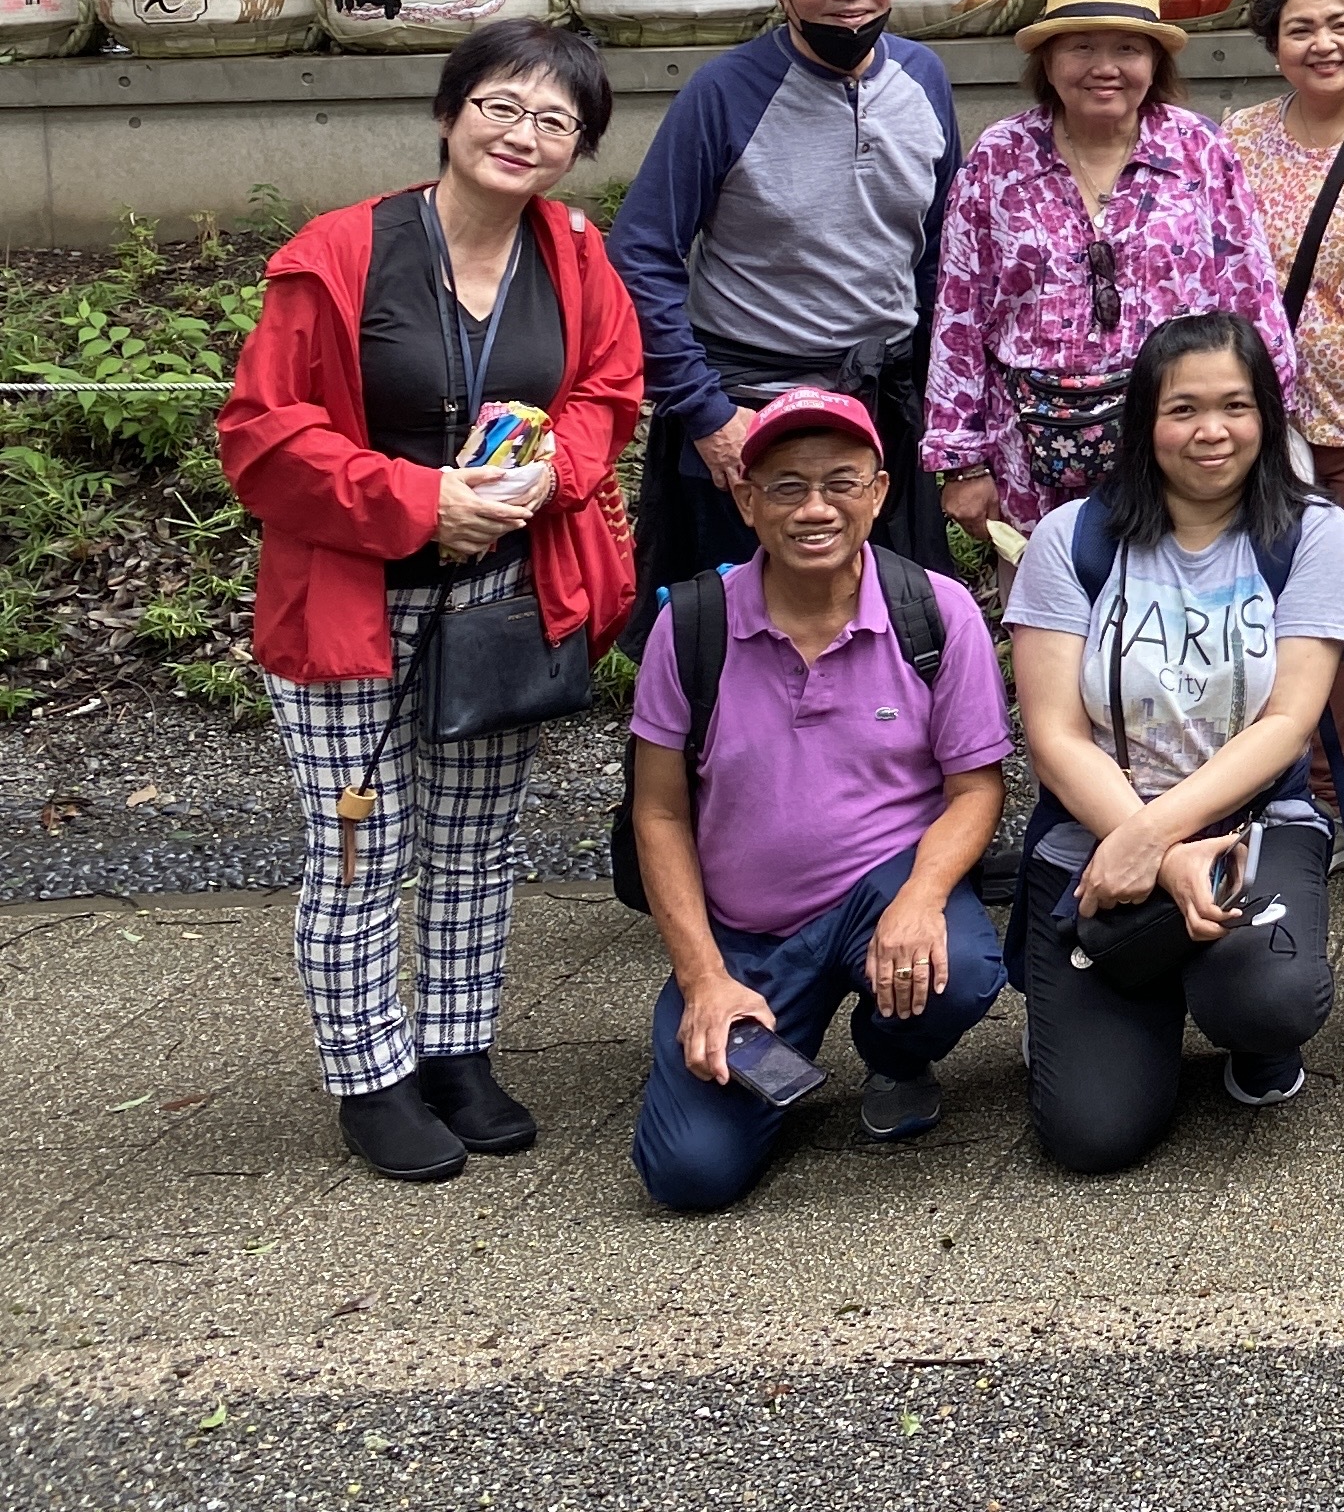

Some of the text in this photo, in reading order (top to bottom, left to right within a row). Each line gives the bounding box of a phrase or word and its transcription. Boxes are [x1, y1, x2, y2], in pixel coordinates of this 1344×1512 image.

[788, 390, 820, 401] YORK
[821, 394, 849, 406] CITY
[1098, 595, 1269, 666] PARIS
[1159, 667, 1209, 702] City
